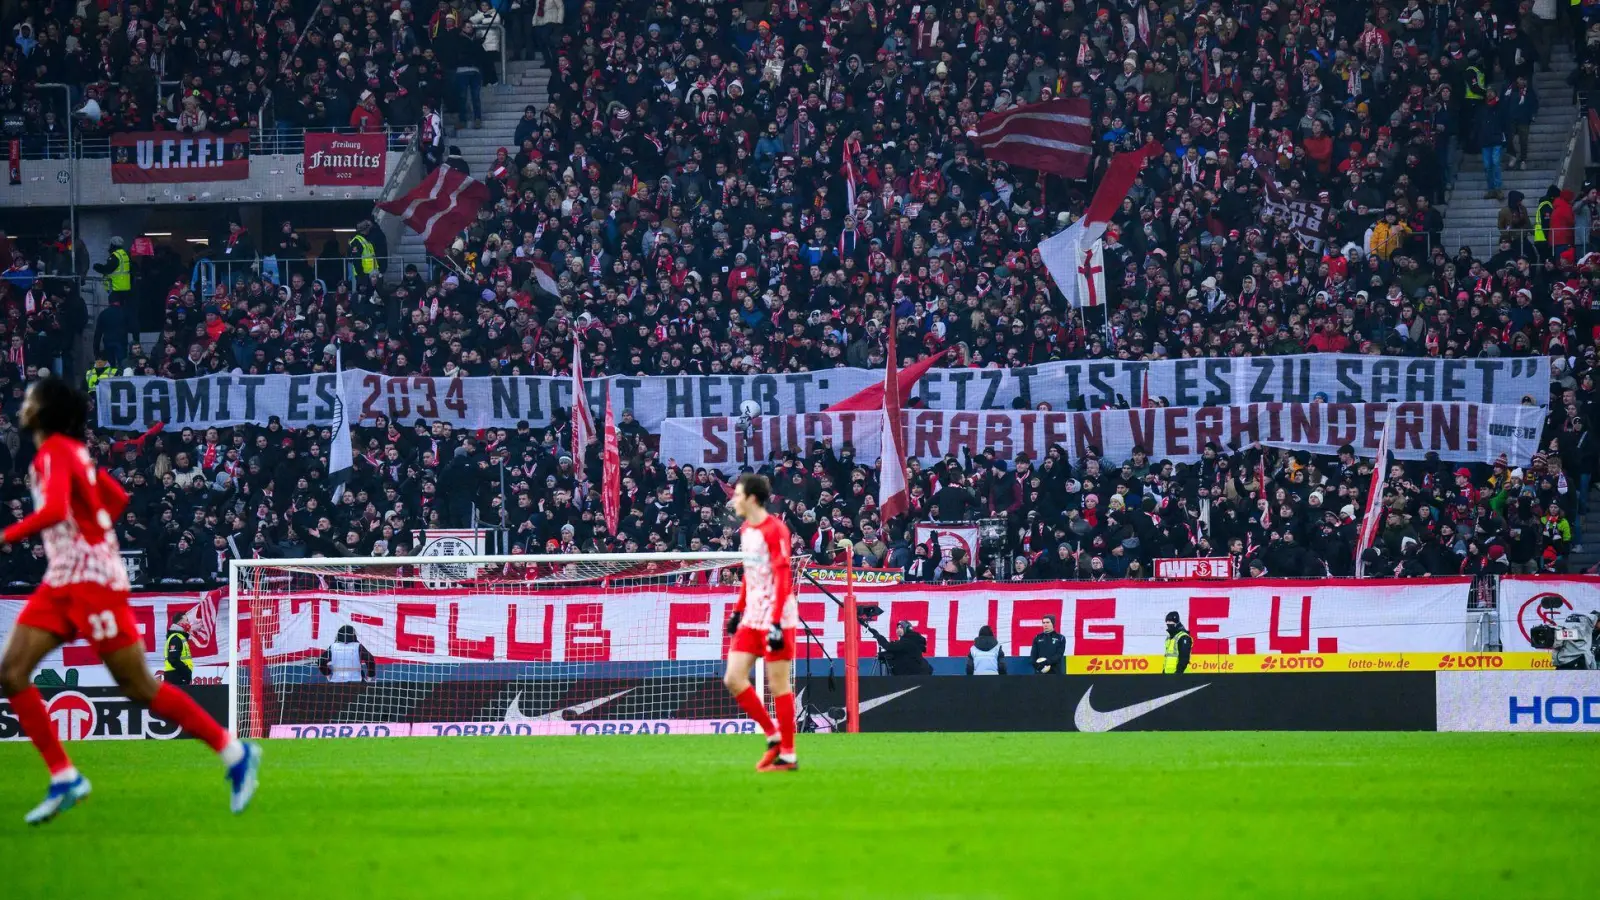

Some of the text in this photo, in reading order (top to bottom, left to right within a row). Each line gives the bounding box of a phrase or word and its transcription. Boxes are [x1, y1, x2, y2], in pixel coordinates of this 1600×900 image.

[136, 138, 224, 170] U.F.F.F.!
[331, 140, 361, 150] Freiburg
[308, 150, 381, 169] Fanatics
[110, 376, 265, 426] DAMIT
[287, 375, 337, 421] ES
[362, 375, 468, 419] 2034
[491, 377, 641, 419] NICHT
[919, 366, 1037, 410] ETZT
[1065, 362, 1150, 411] IST
[1175, 358, 1231, 406] ES
[1250, 358, 1310, 403] ZU
[703, 402, 1478, 463] SAUDI RABIEN VERHINDERN!
[89, 610, 118, 640] 33
[1105, 658, 1149, 671] LOTTO
[1279, 657, 1324, 669] LOTTO
[1348, 657, 1410, 669] lotto-bw.de
[1458, 655, 1503, 668] LOTTO
[291, 726, 390, 738] JOBRAD
[432, 724, 532, 736] JOBRAD
[570, 722, 670, 735] JOBRAD
